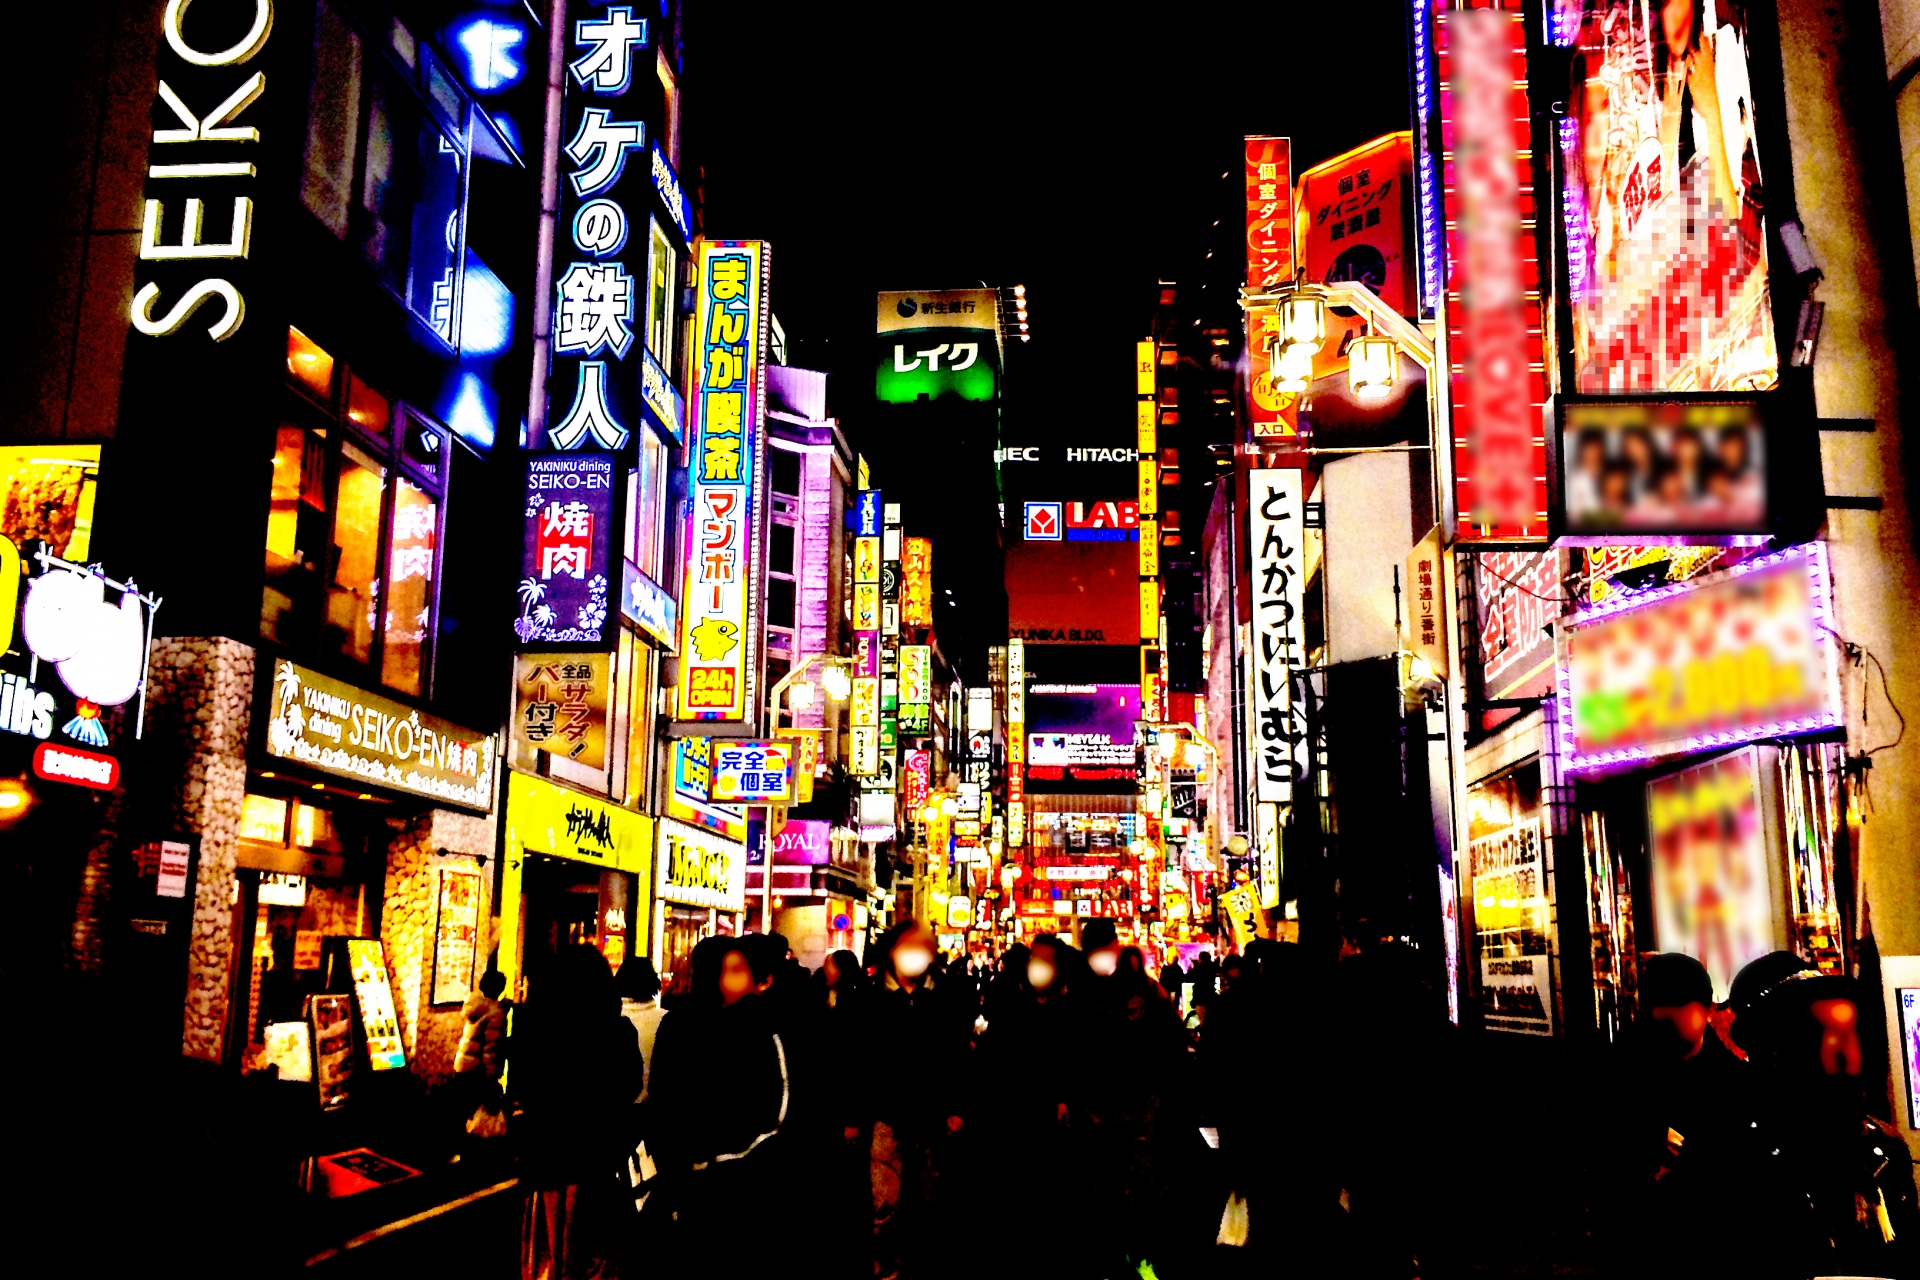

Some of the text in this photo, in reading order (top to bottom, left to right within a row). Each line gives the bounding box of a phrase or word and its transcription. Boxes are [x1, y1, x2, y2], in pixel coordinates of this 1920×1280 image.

[131, 0, 273, 342] SEIKO
[1337, 168, 1371, 196] 個室
[1317, 179, 1393, 226] ダイニング
[549, 6, 648, 451] オケの鉄人
[921, 300, 976, 315] 新生銀行
[893, 342, 979, 373] レイク
[1259, 424, 1284, 435] 入口
[528, 473, 611, 489] SEIKO-EN
[529, 460, 611, 474] YAKINIKU dining
[540, 500, 590, 581] 焼肉
[704, 490, 736, 612] マンボー
[1418, 559, 1436, 646] 劇場通り一番街
[1011, 629, 1067, 641] YUNIKA
[1259, 485, 1302, 784] とんかつにいむら
[561, 664, 591, 679] 全品
[691, 671, 734, 690] 24h
[303, 686, 350, 721] YAKINIKU
[525, 663, 560, 742] バー付き
[690, 690, 732, 706] OPEN
[308, 711, 342, 744] dining
[349, 703, 447, 771] SEIKO-EN
[721, 751, 765, 771] 完全
[740, 772, 783, 792] 個室
[1903, 994, 1915, 1008] 6F
